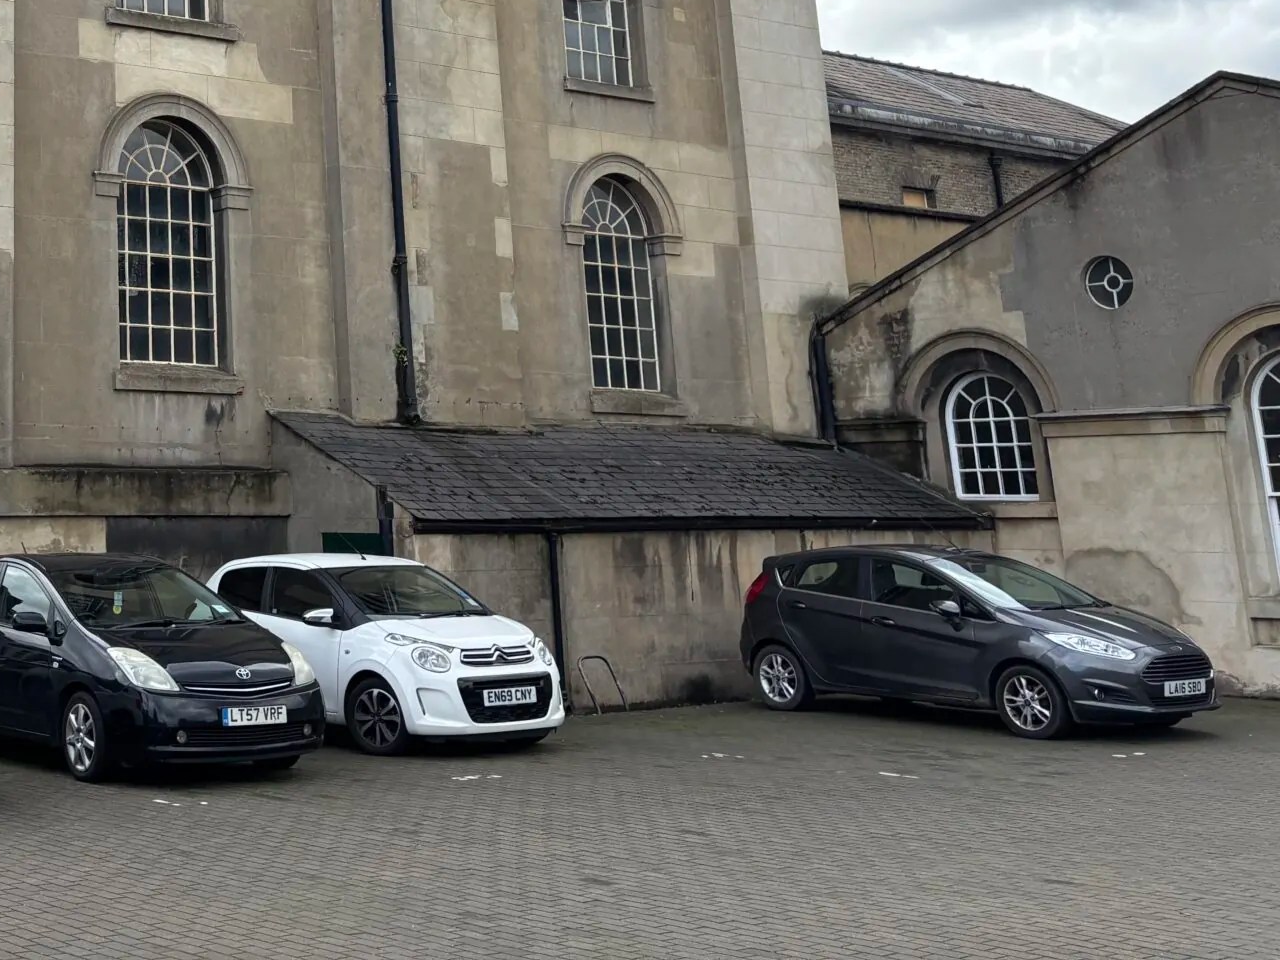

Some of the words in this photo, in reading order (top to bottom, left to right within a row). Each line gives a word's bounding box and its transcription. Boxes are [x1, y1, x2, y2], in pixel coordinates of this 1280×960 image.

[487, 690, 513, 703] EN69
[515, 688, 532, 701] CNY
[1169, 682, 1186, 695] LA16
[230, 708, 260, 722] LT57
[263, 706, 283, 721] VRF
